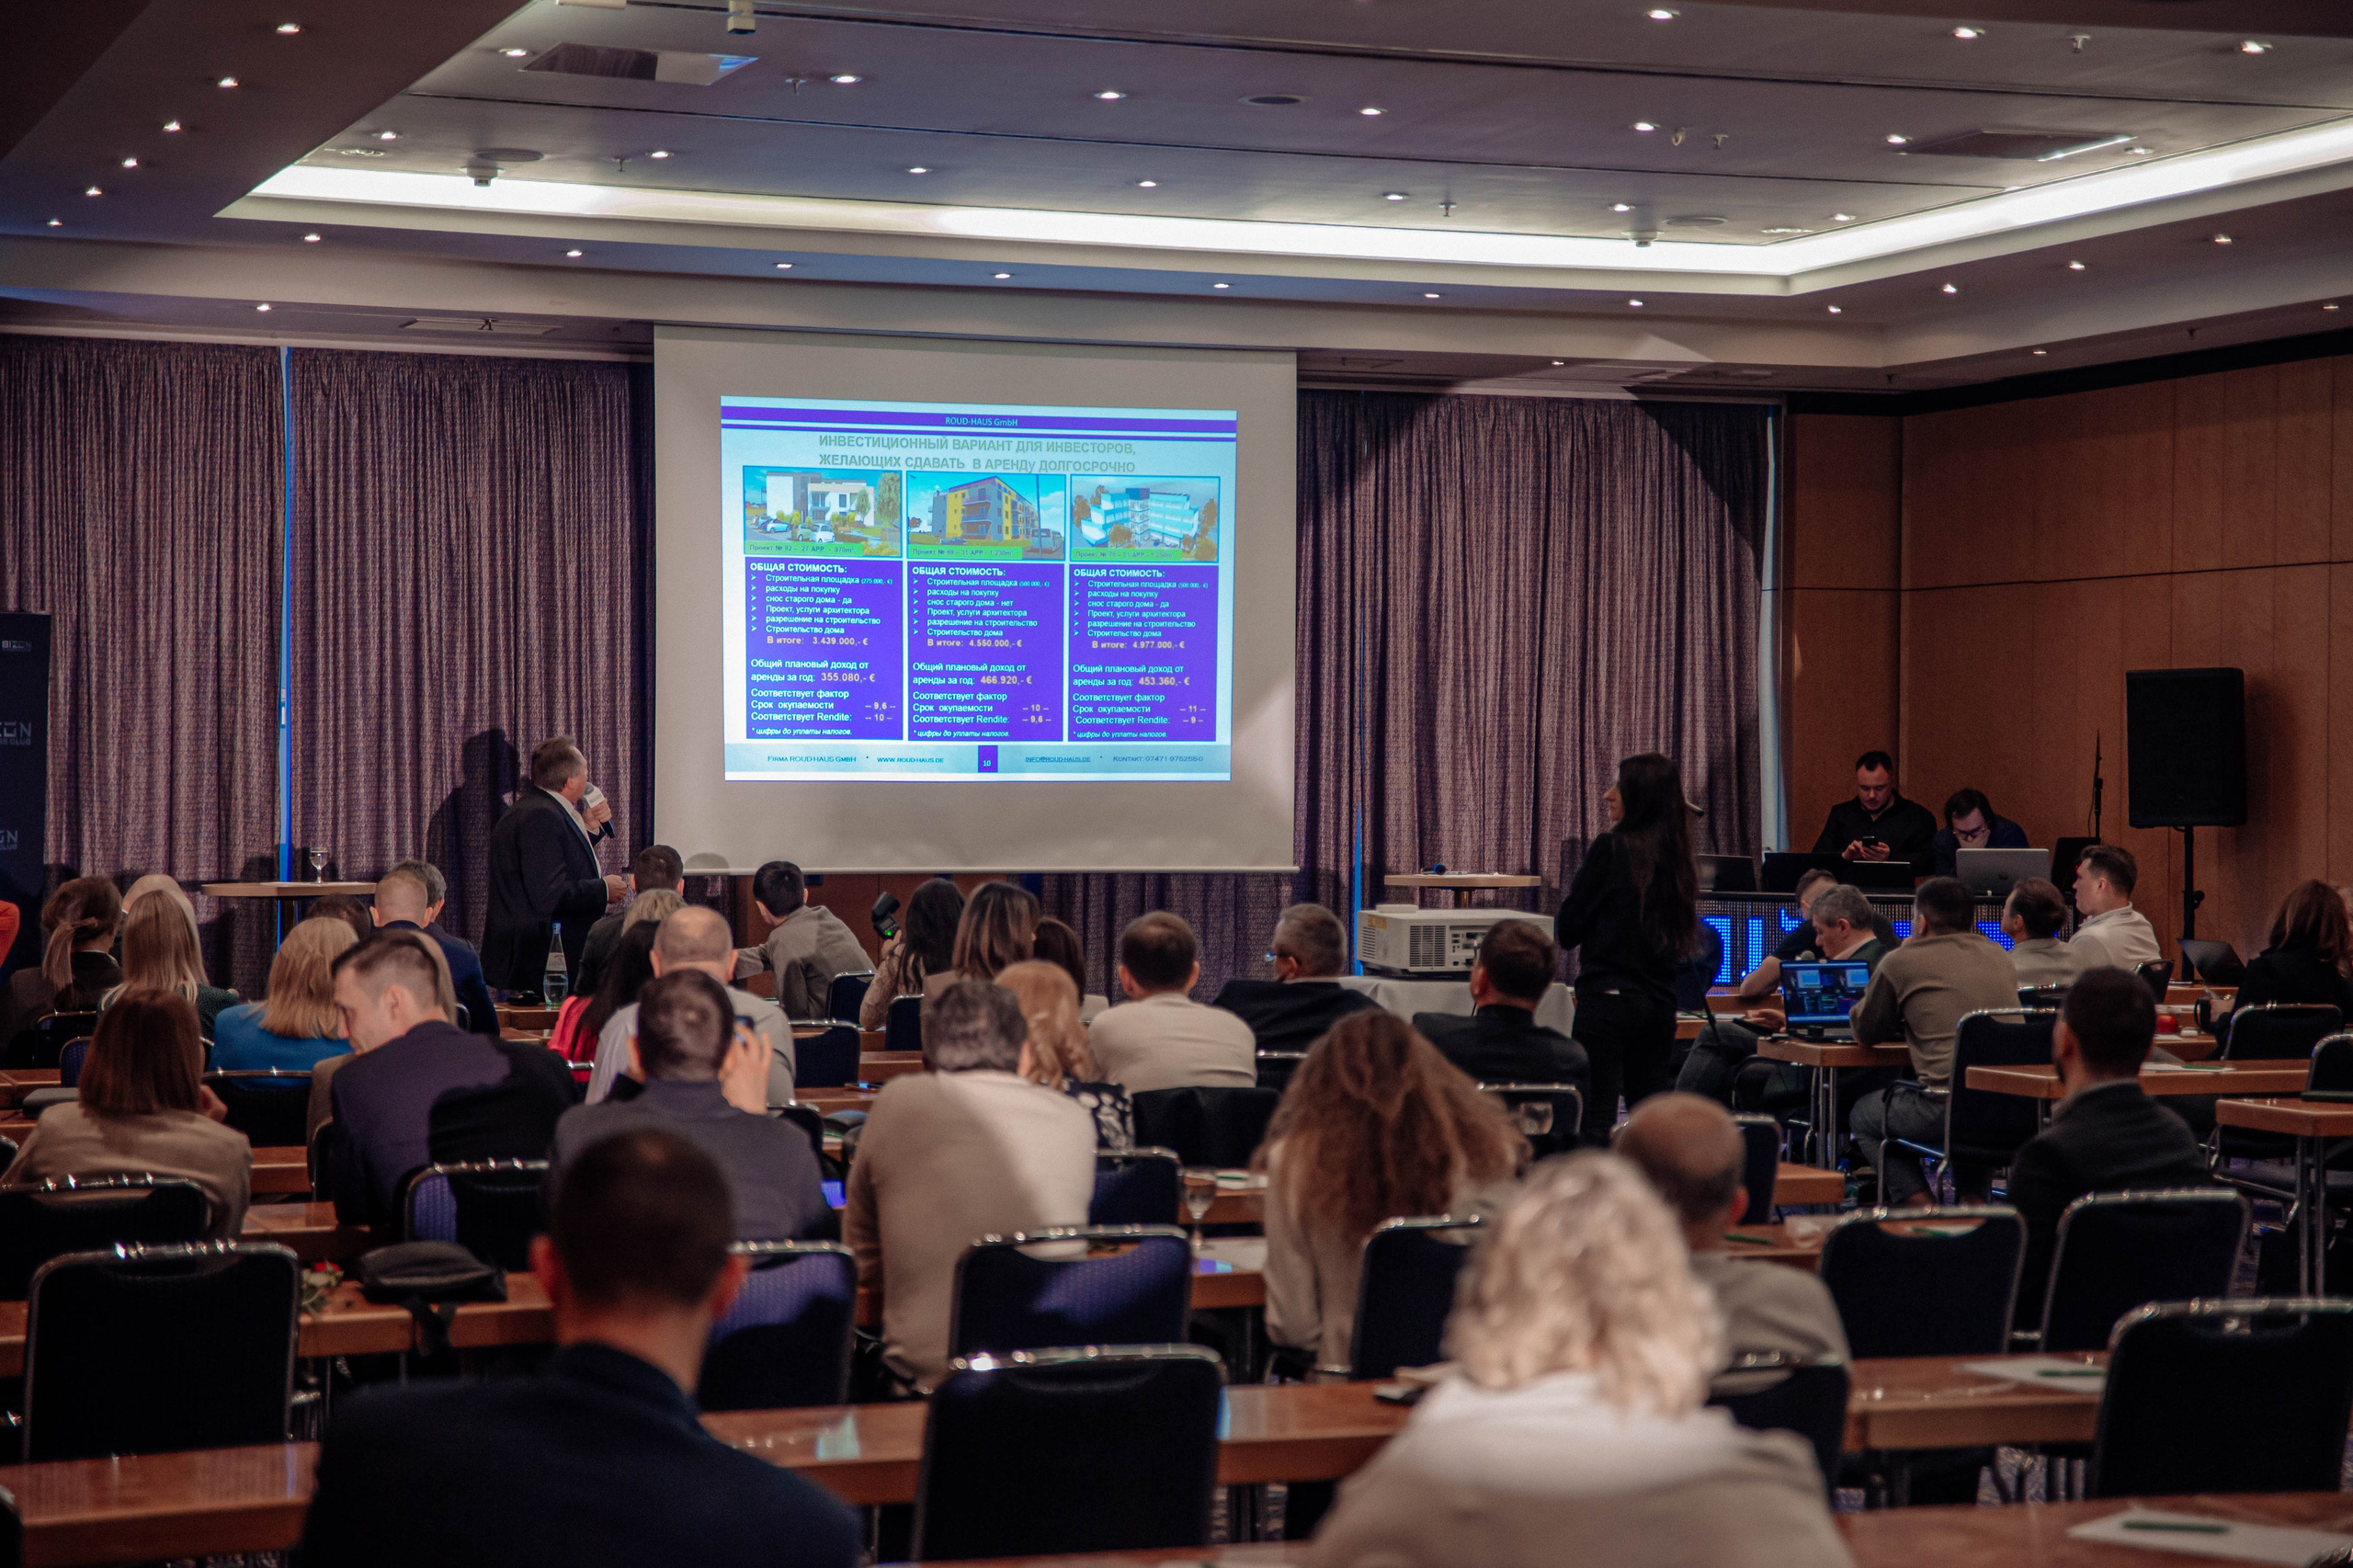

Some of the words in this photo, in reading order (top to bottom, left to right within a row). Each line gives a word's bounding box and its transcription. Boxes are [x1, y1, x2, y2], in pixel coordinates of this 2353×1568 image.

[945, 416, 993, 426] ROUD-HAUS
[994, 418, 1018, 426] GmbH
[820, 435, 949, 449] ИНВЕСТИЦИОННЫЙ
[952, 438, 1013, 451] ВАРИАНТ
[1016, 441, 1041, 452] ДЛЯ
[1047, 442, 1136, 455] ИНВЕСТОРОВ,
[819, 454, 901, 468] ЖЕЛАЮЩИХ
[905, 457, 965, 470] СДАВАТЬ
[972, 460, 981, 469] В
[1039, 460, 1135, 472] ДОЛГОСРОЧНО
[750, 562, 784, 573] ОБЩАЯ
[788, 563, 847, 573] СТОИМОСТЬ:
[913, 567, 946, 576] ОБЩАЯ
[949, 567, 1006, 576] СТОИМОСТЬ:
[1074, 569, 1107, 578] ОБЩАЯ
[1109, 569, 1165, 577] СТОИМОСТЬ:
[766, 574, 819, 583] Строительная
[927, 578, 979, 586] Строительная
[812, 586, 840, 595] покупку
[766, 605, 794, 614] Проект,
[927, 608, 955, 617] Проект,
[766, 616, 813, 624] разрешение
[927, 619, 972, 627] разрешение
[766, 625, 823, 633] Строительство
[1087, 630, 1142, 638] Строительство
[751, 659, 782, 669] Общий
[785, 660, 828, 668] плановый
[913, 663, 943, 672] Общий
[1074, 665, 1103, 674] Общий
[751, 674, 784, 682] аренды
[751, 688, 814, 699] Соответствует
[817, 690, 849, 699] фактор
[913, 691, 974, 701] Соответствует
[976, 693, 1007, 702] фактор
[1073, 693, 1132, 703] Соответствует
[1134, 693, 1165, 702] фактор
[751, 700, 773, 710] Срок
[779, 702, 834, 710] окупаемости
[913, 703, 934, 712] Срок
[939, 705, 993, 713] окупаемости
[1073, 705, 1093, 714] Срок
[1098, 706, 1151, 714] окупаемости
[751, 712, 814, 722] Соответствует
[913, 714, 974, 725] Соответствует
[977, 715, 1009, 723] Rendite:
[1137, 716, 1170, 724] Rendite:
